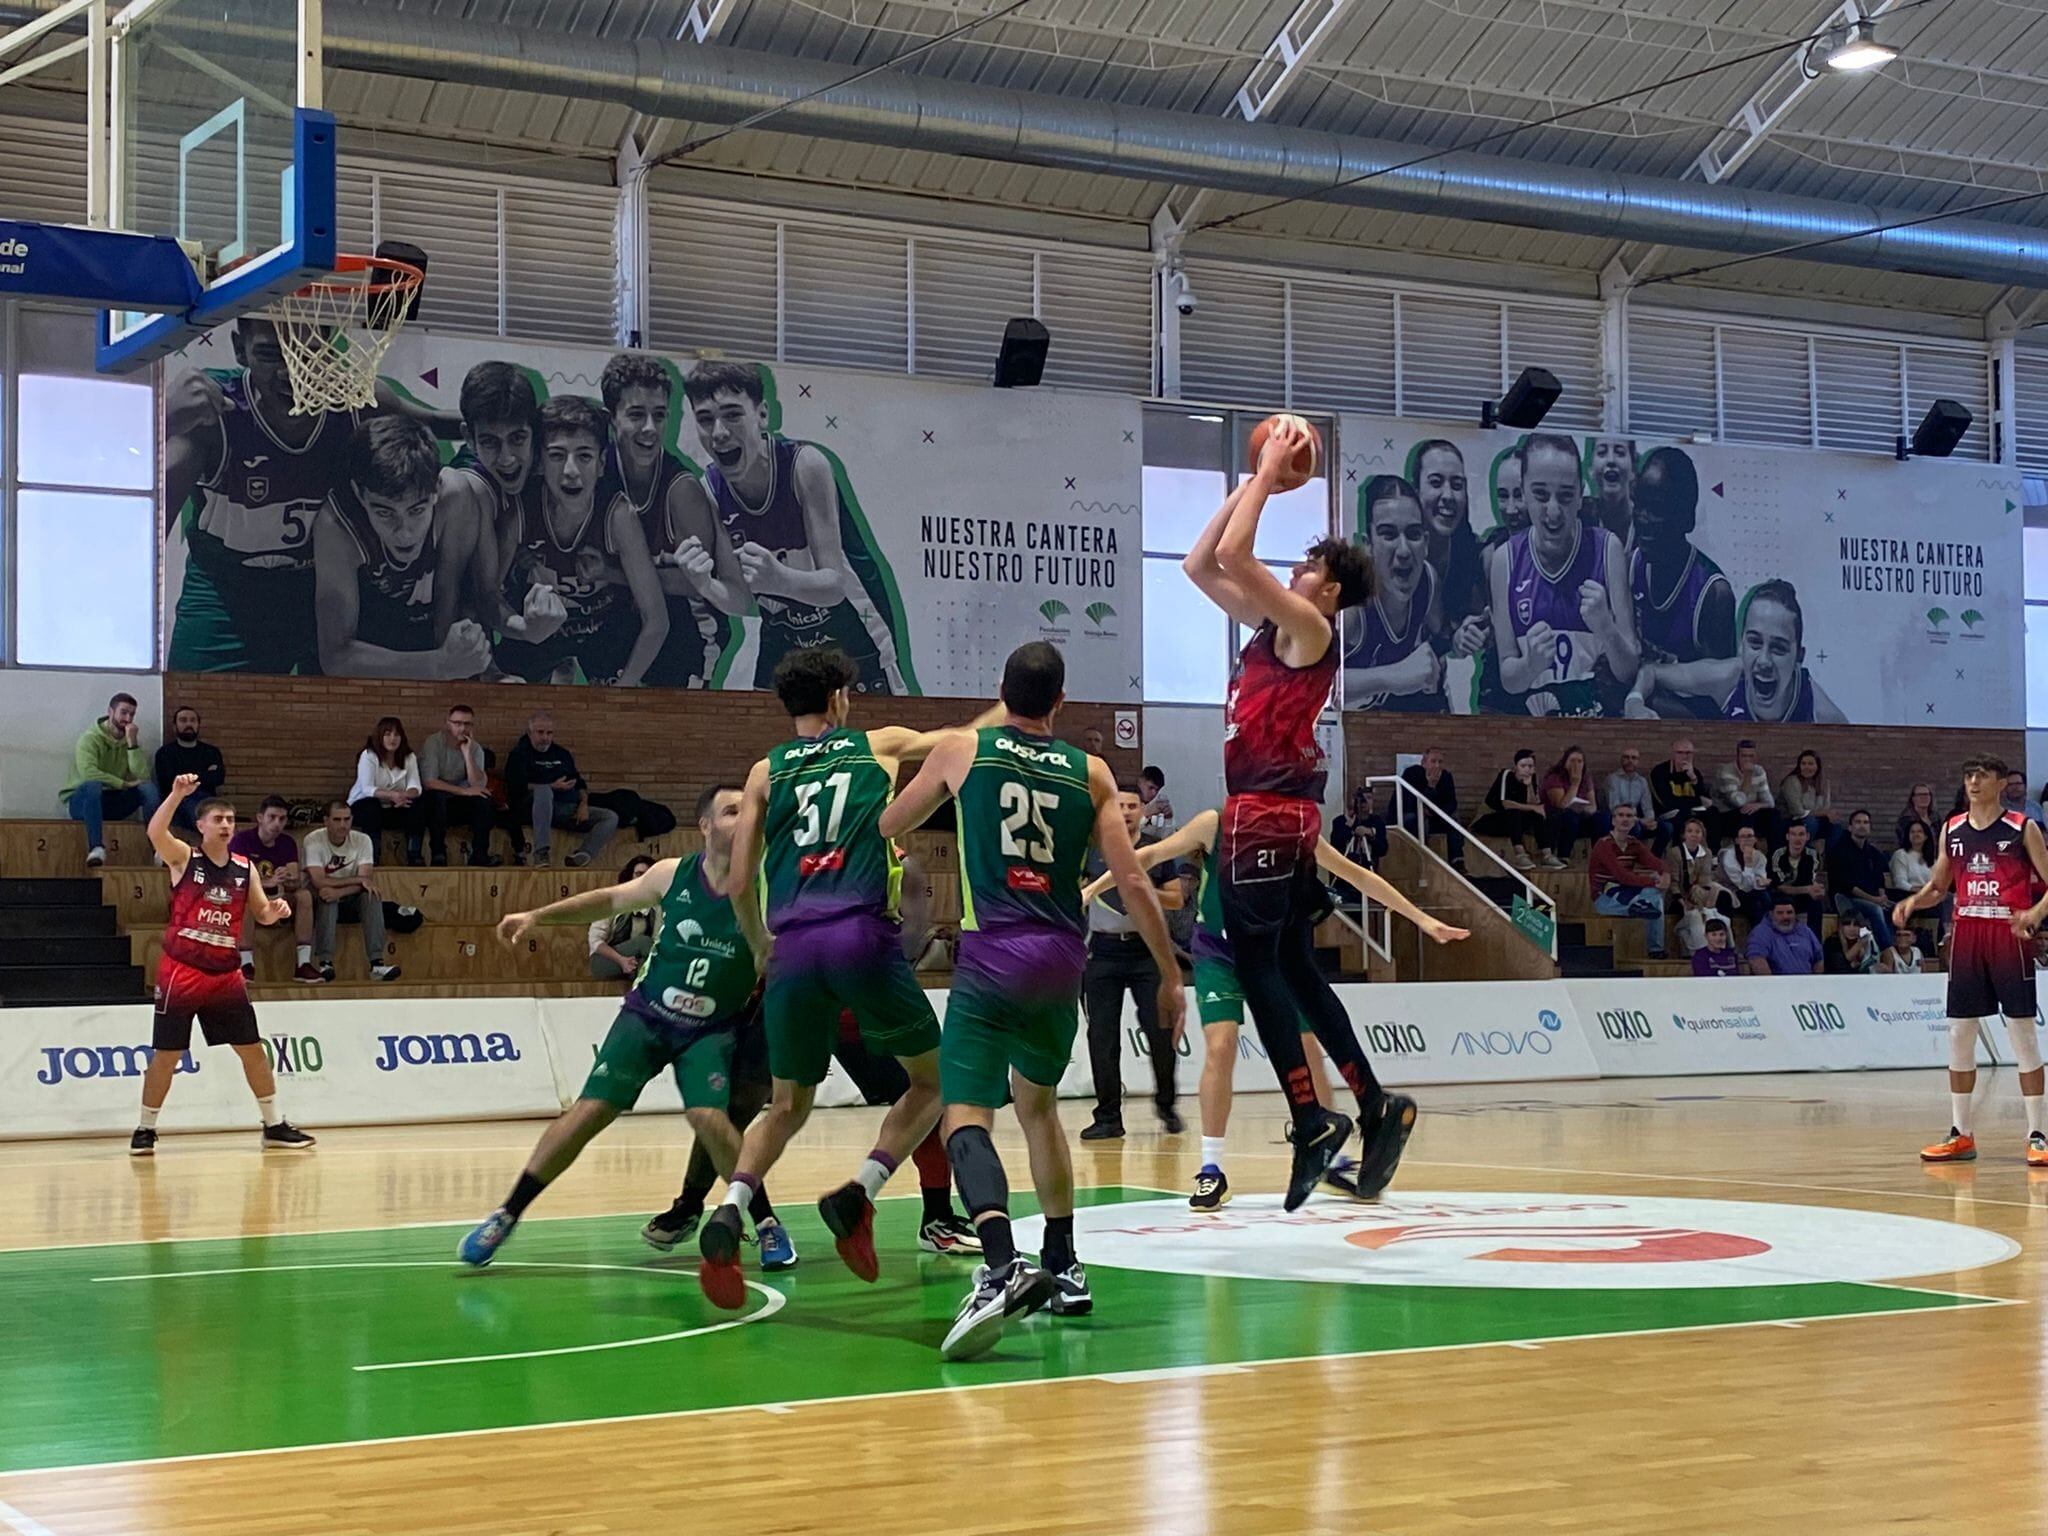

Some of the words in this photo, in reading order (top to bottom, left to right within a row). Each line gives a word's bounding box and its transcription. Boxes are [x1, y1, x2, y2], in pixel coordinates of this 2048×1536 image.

[0, 238, 29, 257] de
[0, 262, 25, 274] nal
[921, 515, 1016, 548] NUESTRA
[1027, 522, 1118, 554] CANTERA
[1840, 536, 1909, 564] NUESTRA
[1916, 541, 1984, 569] CANTERA
[923, 548, 1023, 583] NUESTRO
[1035, 555, 1115, 588] FUTURO
[1842, 565, 1914, 593] NUESTRO
[1923, 569, 1983, 597] FUTURO
[994, 736, 1072, 769] austral
[1000, 781, 1060, 864] 25
[37, 838, 46, 851] 2
[110, 839, 120, 851] 3
[648, 843, 660, 855] 11
[1951, 843, 1964, 857] 71
[134, 886, 143, 899] 3
[419, 885, 429, 897] 7
[490, 885, 498, 897] 8
[560, 885, 569, 898] 9
[1967, 880, 2000, 897] MAR
[197, 907, 232, 927] MAR
[387, 943, 396, 955] 6
[457, 941, 466, 954] 7
[528, 939, 537, 952] 8
[685, 957, 711, 989] 12
